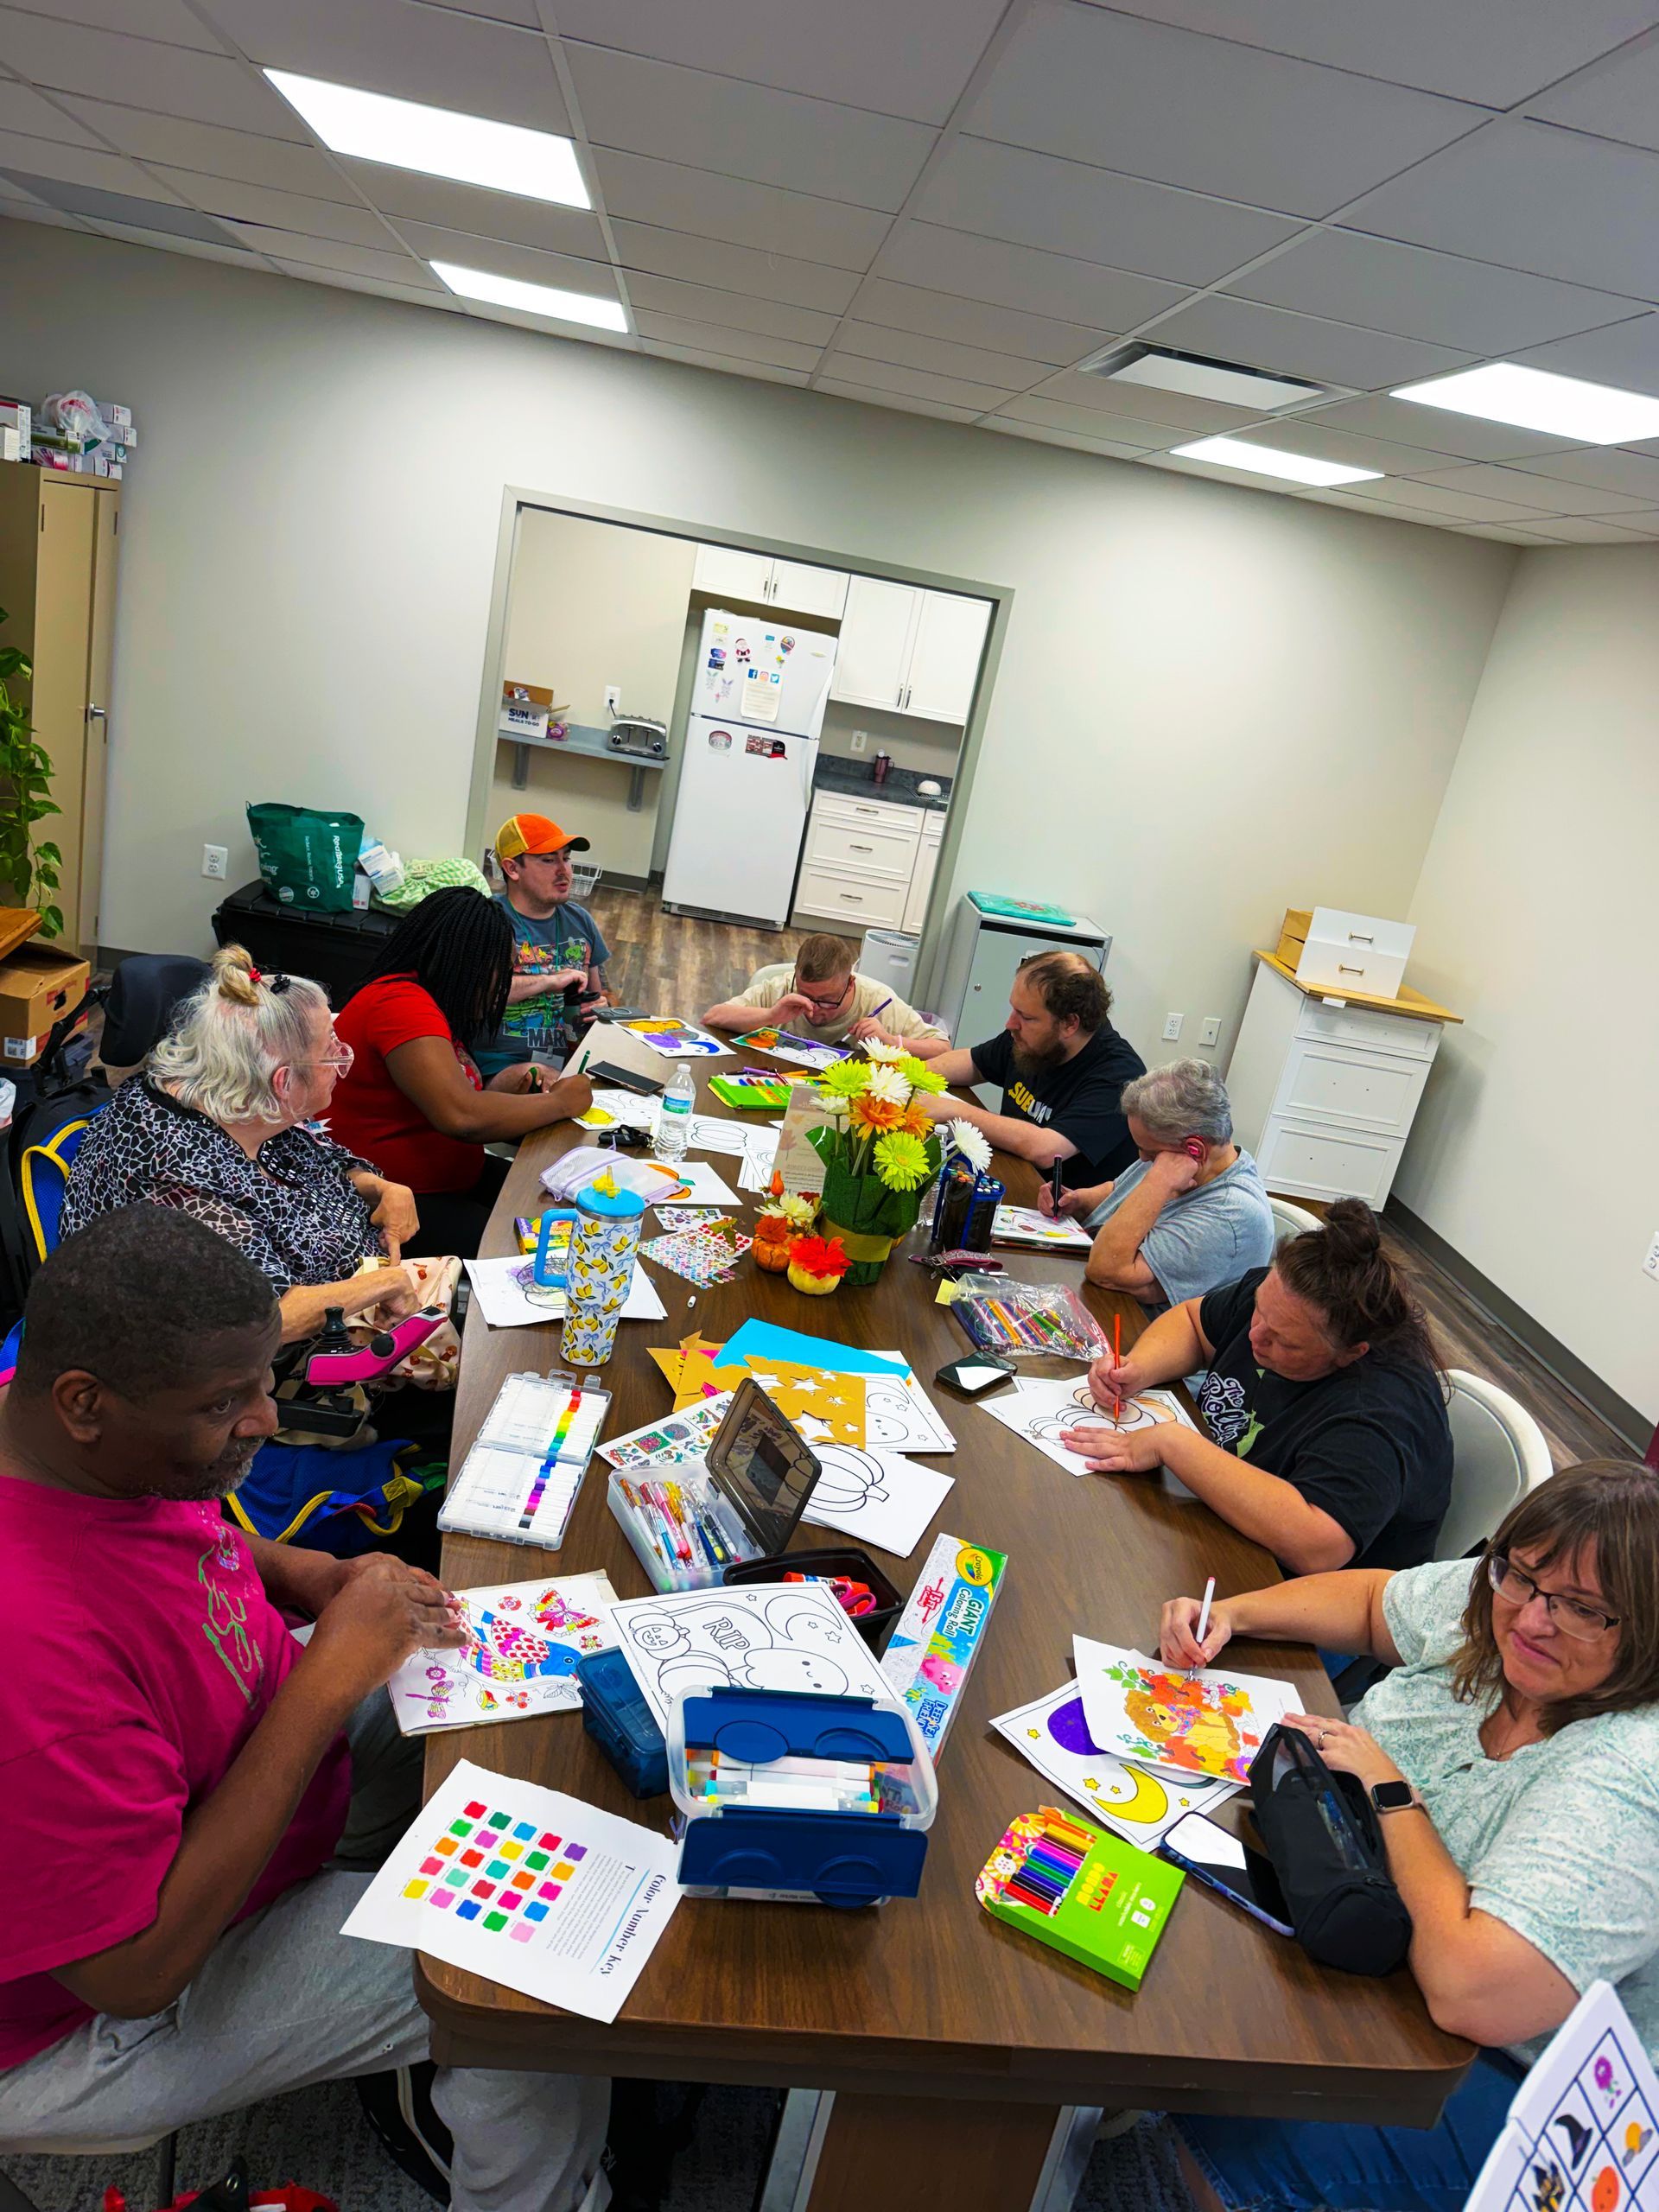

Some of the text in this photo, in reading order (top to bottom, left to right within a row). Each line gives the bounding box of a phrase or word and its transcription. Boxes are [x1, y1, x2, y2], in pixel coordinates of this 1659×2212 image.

[508, 709, 529, 720] SUN
[1224, 1377, 1245, 1408] The
[975, 1555, 983, 1581] Crayola
[944, 1588, 970, 1636] Coloring Roll
[959, 1599, 982, 1635] GIANT
[702, 1617, 750, 1649] RIP
[917, 1699, 934, 1727] FRIEND
[925, 1700, 948, 1738] DEEP SEA
[1076, 1862, 1105, 1906] MONDO
[1089, 1872, 1120, 1912] LLAMA
[600, 1873, 666, 1978] Color Number Key
